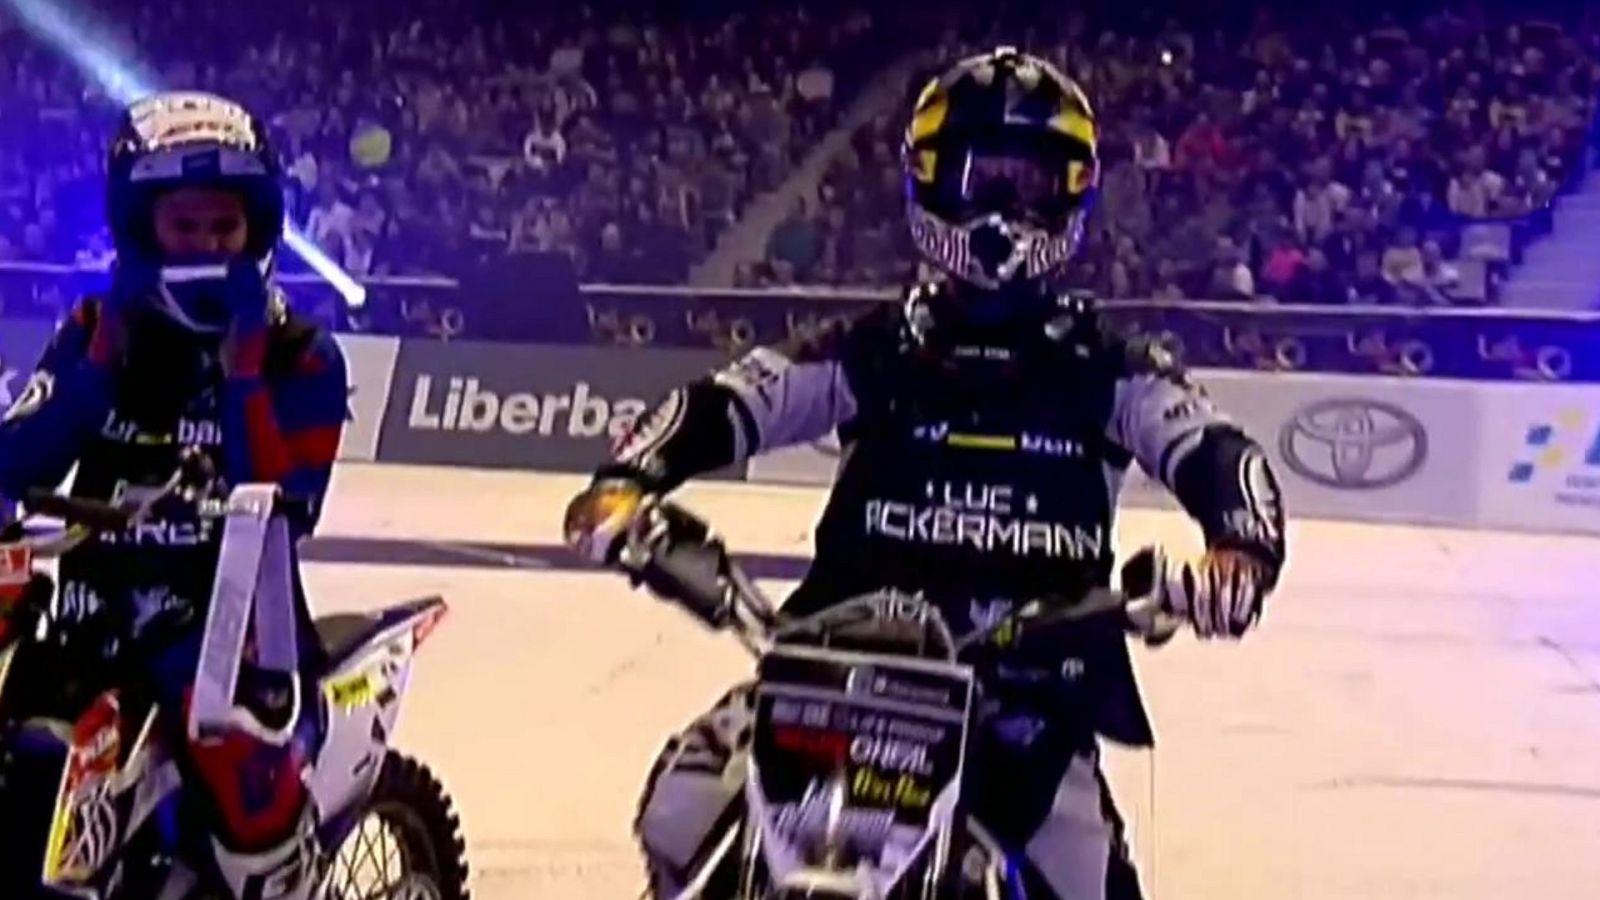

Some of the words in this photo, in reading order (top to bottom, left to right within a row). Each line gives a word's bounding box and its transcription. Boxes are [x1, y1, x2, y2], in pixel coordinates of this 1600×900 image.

[408, 374, 647, 436] Liberba
[944, 481, 1012, 514] LUC
[866, 499, 1102, 560] ACKERMANN
